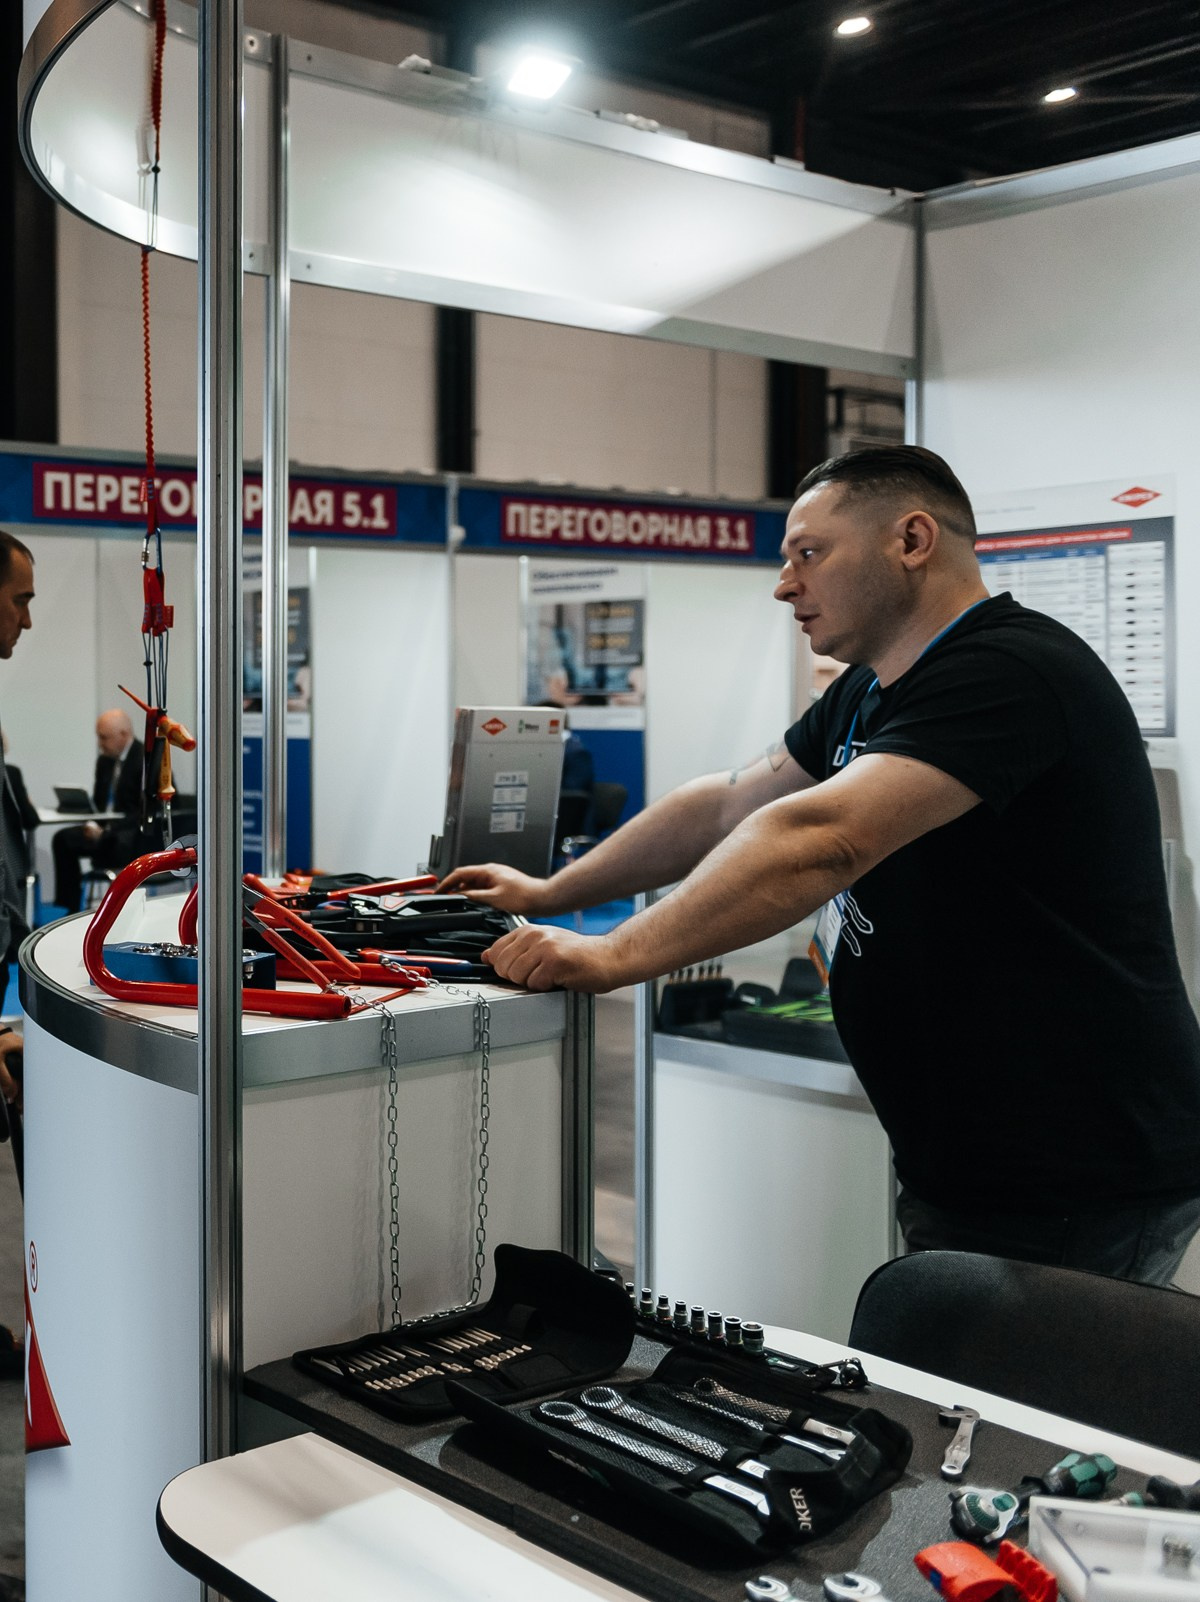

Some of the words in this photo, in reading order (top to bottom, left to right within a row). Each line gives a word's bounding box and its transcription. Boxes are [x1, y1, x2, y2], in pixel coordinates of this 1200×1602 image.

[43, 471, 334, 526] ПЕРЕГОРАЯ
[342, 494, 389, 529] 5.1
[506, 502, 711, 547] ПЕРЕГОВОРНАЯ
[715, 517, 750, 550] 3.1
